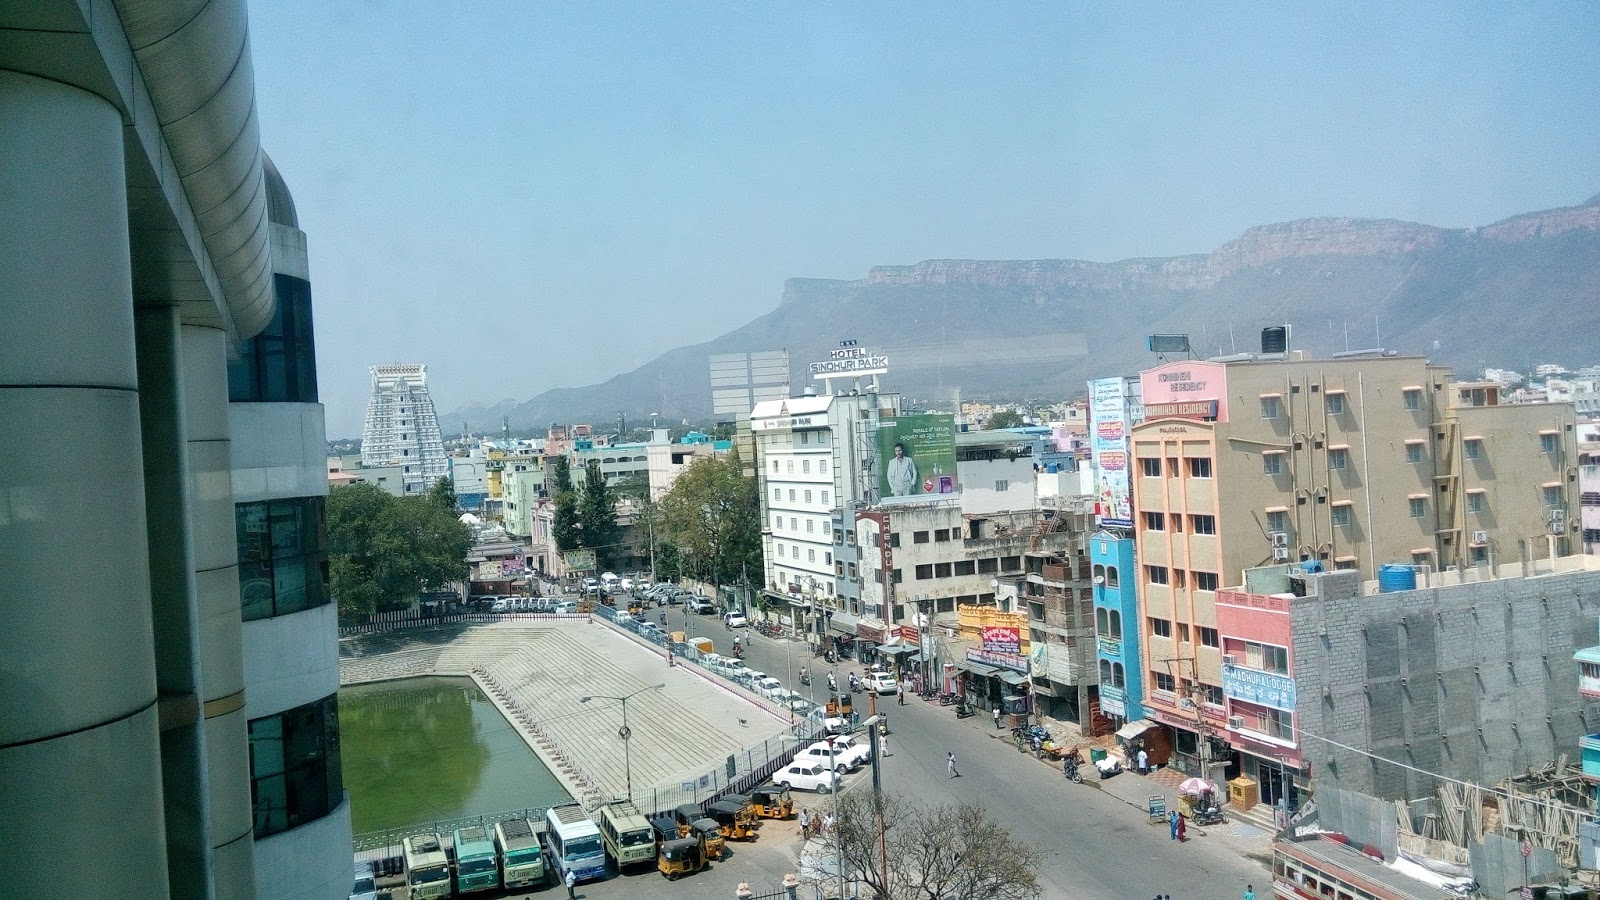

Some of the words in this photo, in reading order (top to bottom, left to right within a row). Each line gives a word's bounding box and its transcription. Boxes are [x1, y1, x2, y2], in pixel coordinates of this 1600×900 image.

[830, 349, 865, 358] HOTEL
[811, 360, 855, 372] SINDHURI
[858, 356, 888, 368] PARK
[1178, 402, 1211, 414] RESIDENCY
[1230, 669, 1266, 687] MADHURA
[1267, 677, 1292, 692] LODGE
